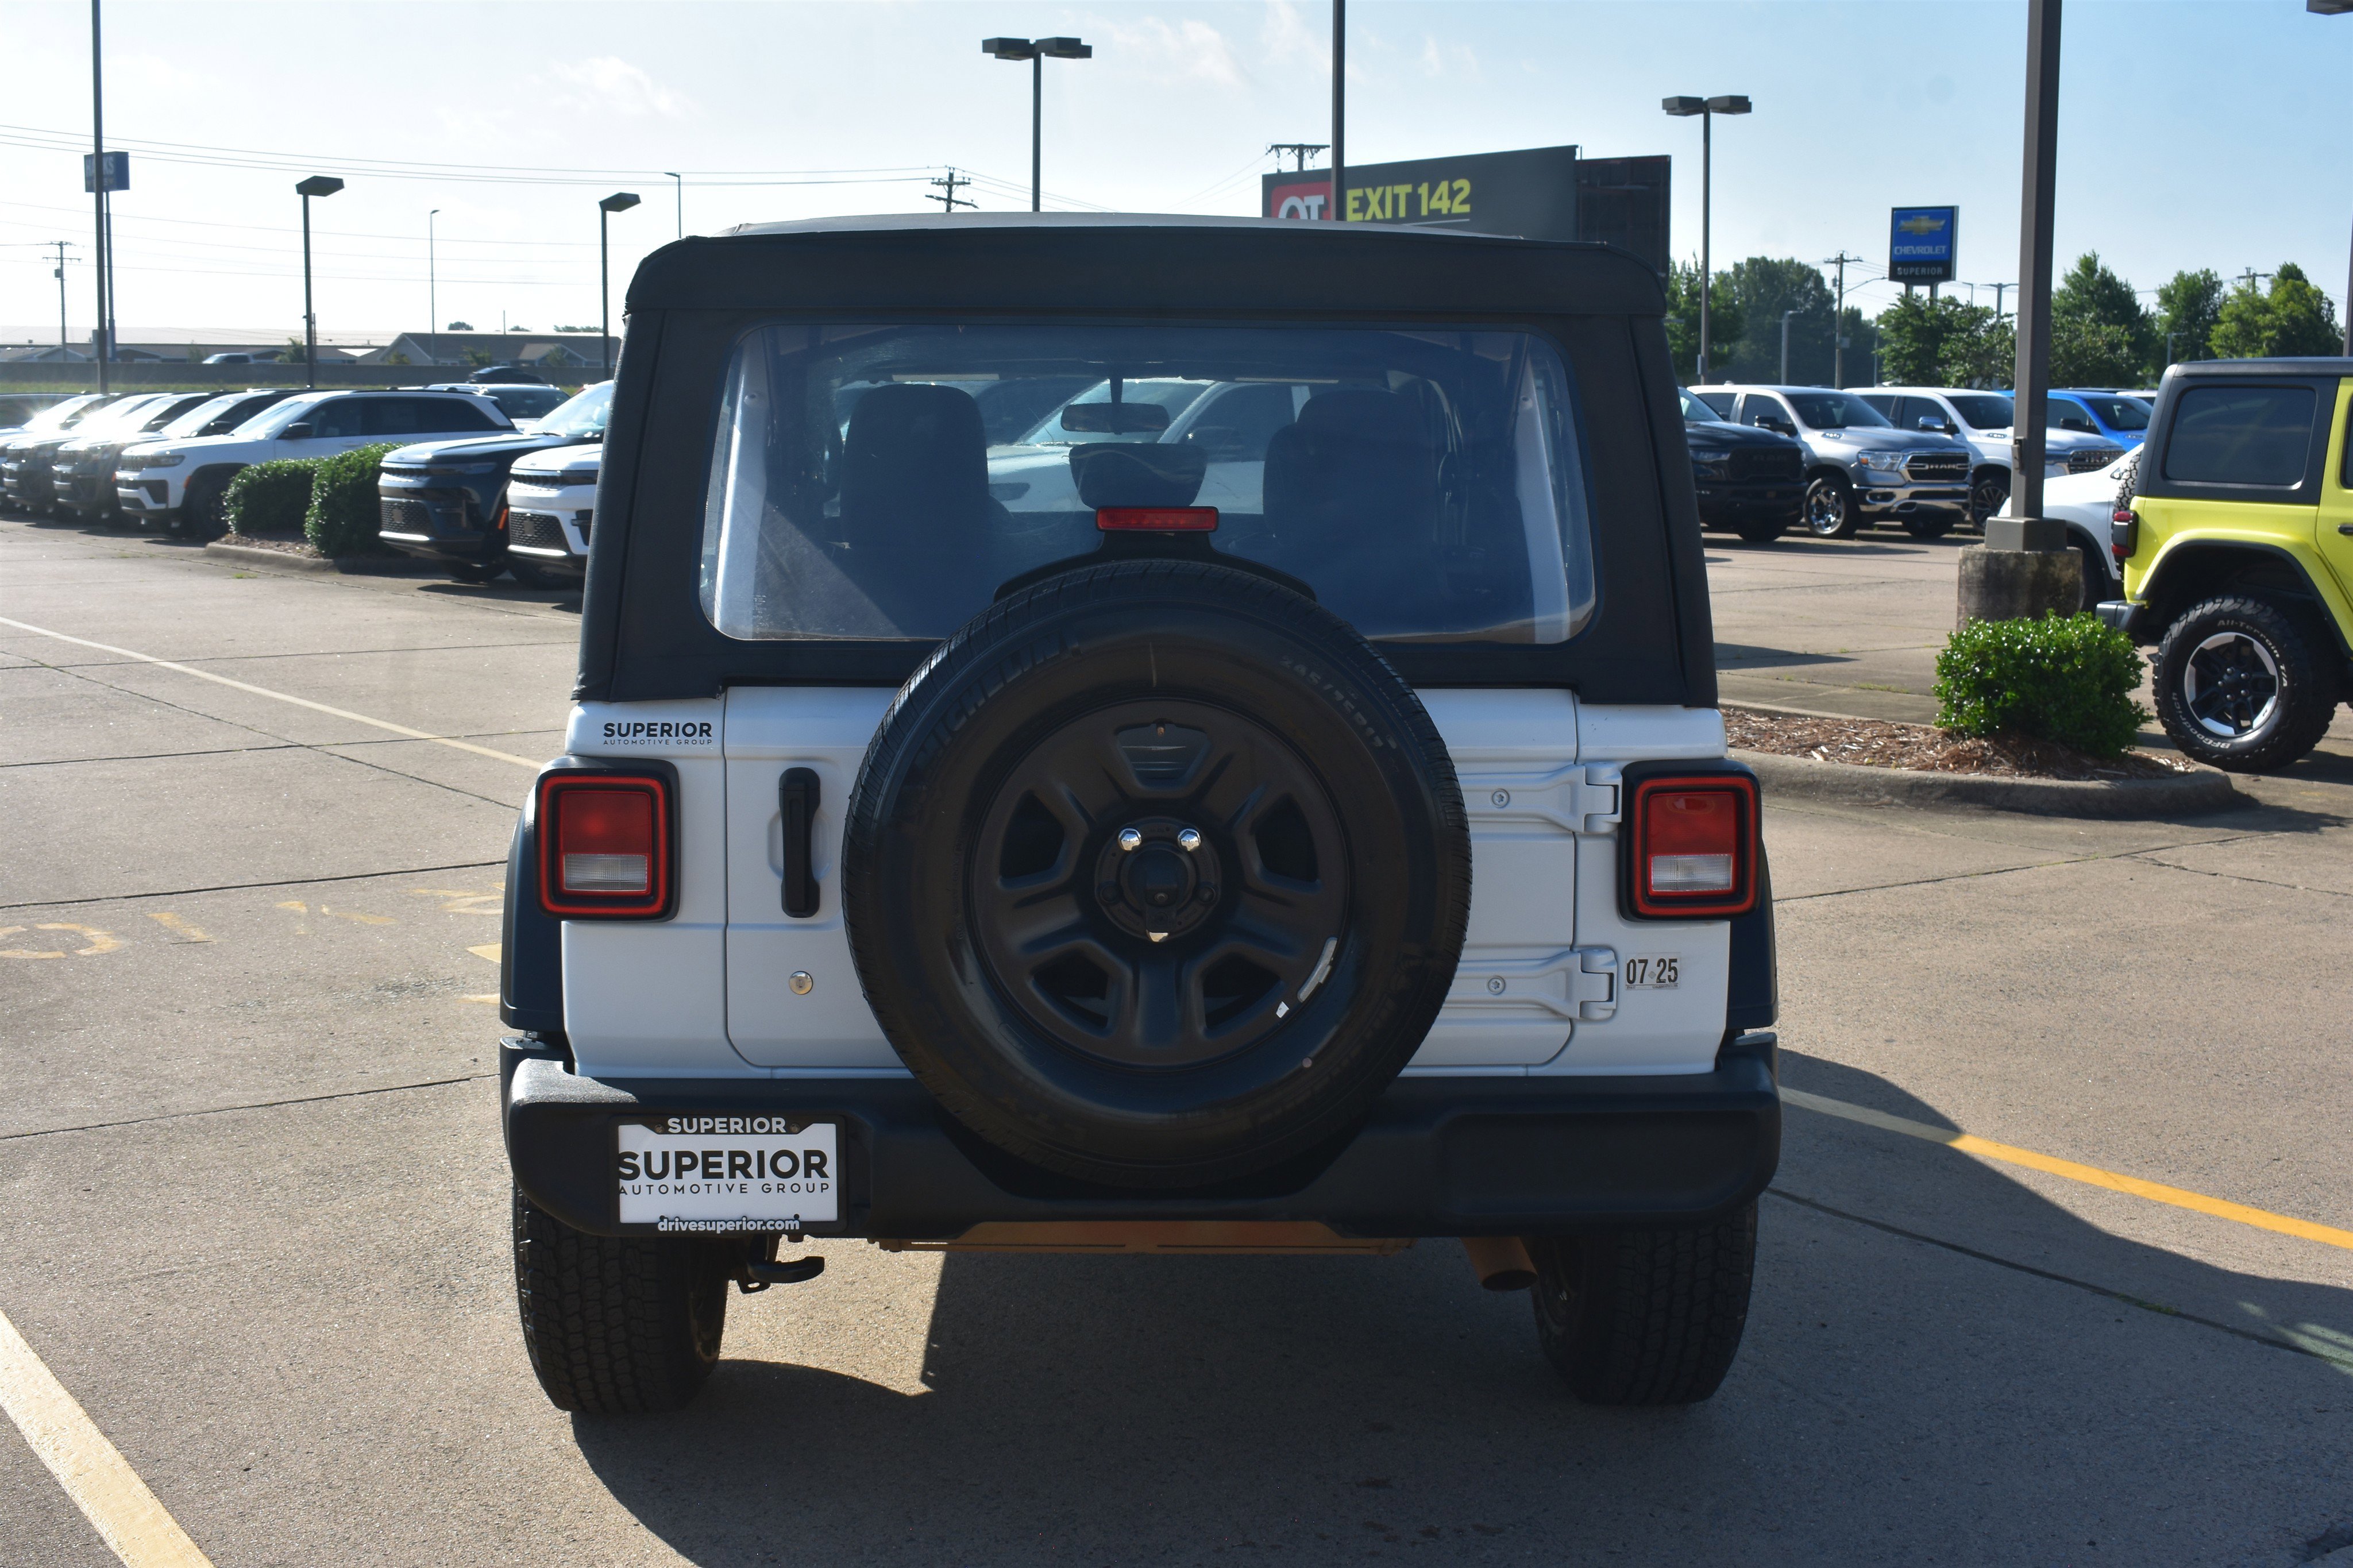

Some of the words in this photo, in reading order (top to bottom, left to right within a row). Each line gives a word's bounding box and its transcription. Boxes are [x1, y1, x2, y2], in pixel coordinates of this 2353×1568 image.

[1346, 184, 1413, 222] EXIT
[1417, 179, 1471, 217] 142
[1895, 245, 1946, 255] CHEVROLET
[1897, 267, 1943, 276] SUPERIOR
[2172, 692, 2231, 749] BFGoodrich
[603, 722, 712, 738] SUPERIOR
[667, 1117, 786, 1134] SUPERIOR
[619, 1149, 830, 1181] SUPERIOR
[619, 1183, 749, 1195] AUTOMOTIVE
[761, 1183, 830, 1194] GROUP
[657, 1216, 800, 1234] drivesuperior.com
